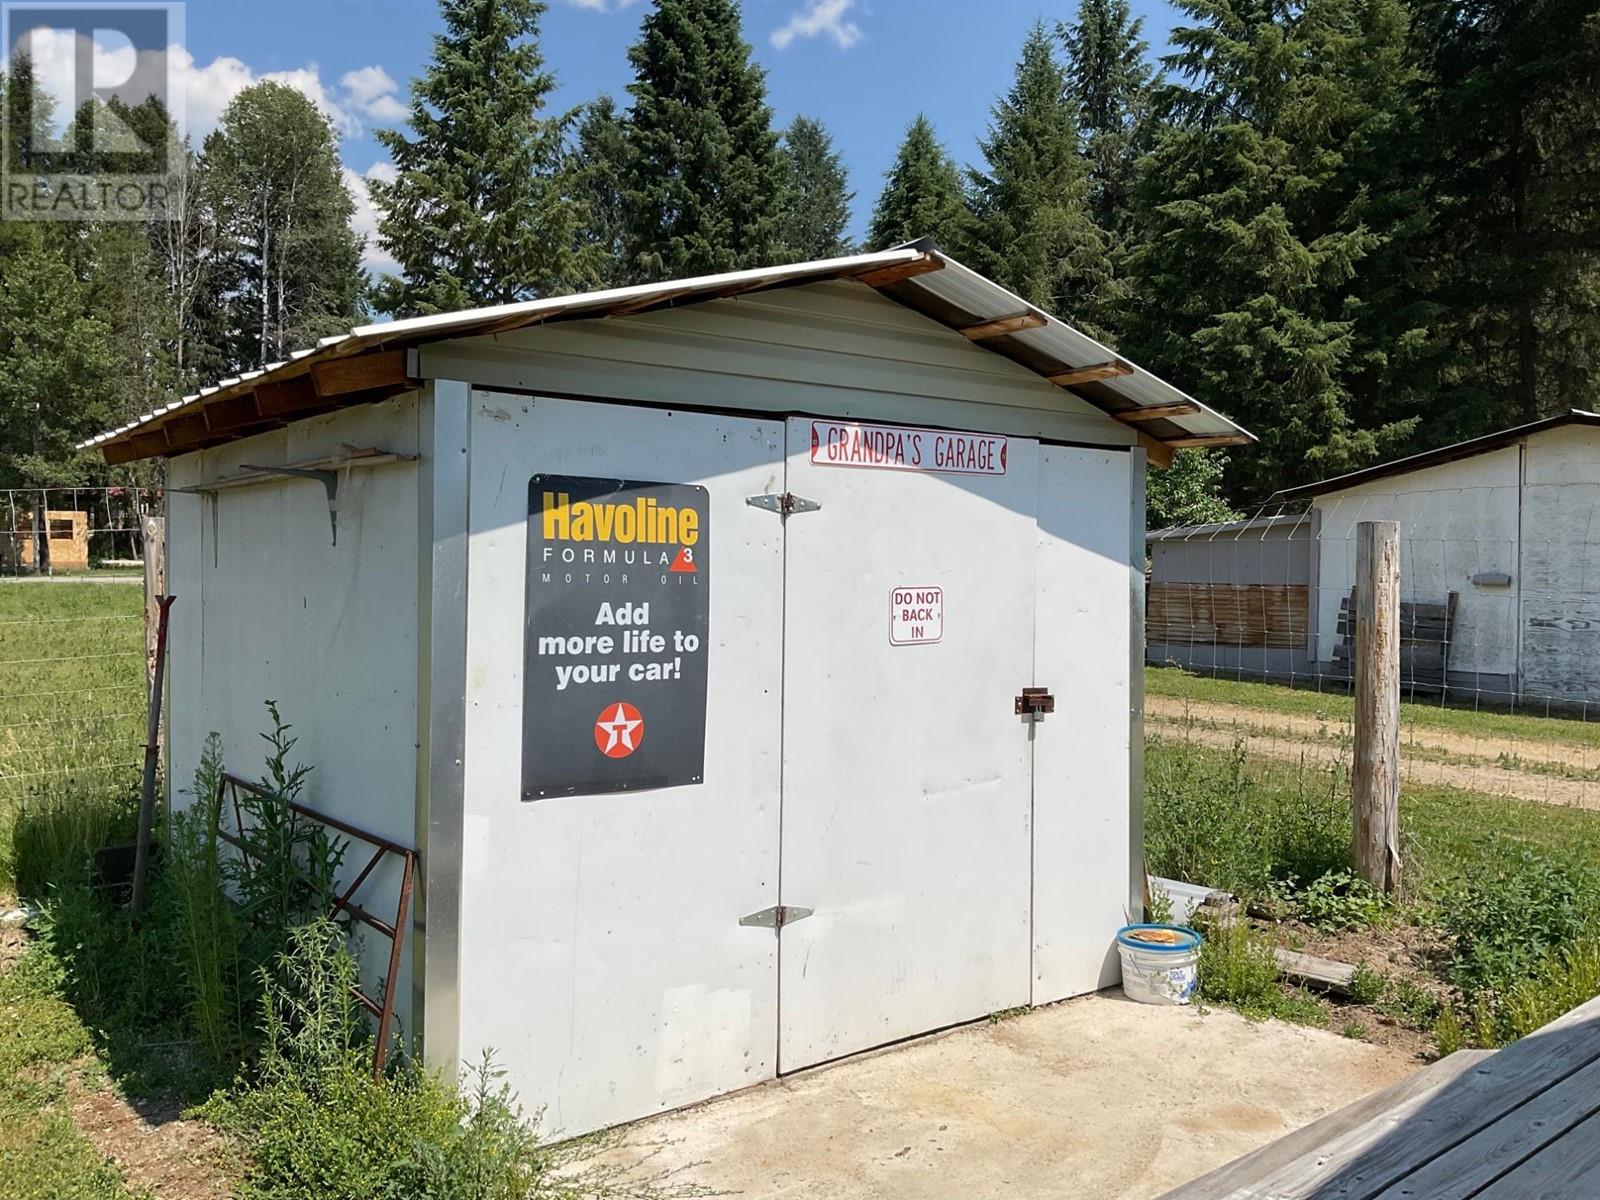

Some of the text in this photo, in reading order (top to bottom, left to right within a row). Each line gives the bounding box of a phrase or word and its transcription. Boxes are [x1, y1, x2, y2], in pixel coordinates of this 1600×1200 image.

[828, 427, 995, 470] GRANDPA'S GARAGE
[543, 492, 699, 546] Havoline
[543, 548, 693, 565] FORMULA 3
[542, 573, 698, 585] MOTOR OIL
[895, 591, 940, 605] DO NOT
[595, 602, 649, 625] Add
[902, 608, 933, 621] BACK
[911, 625, 924, 638] IN
[538, 630, 699, 655] more life to
[555, 657, 681, 690] your car!
